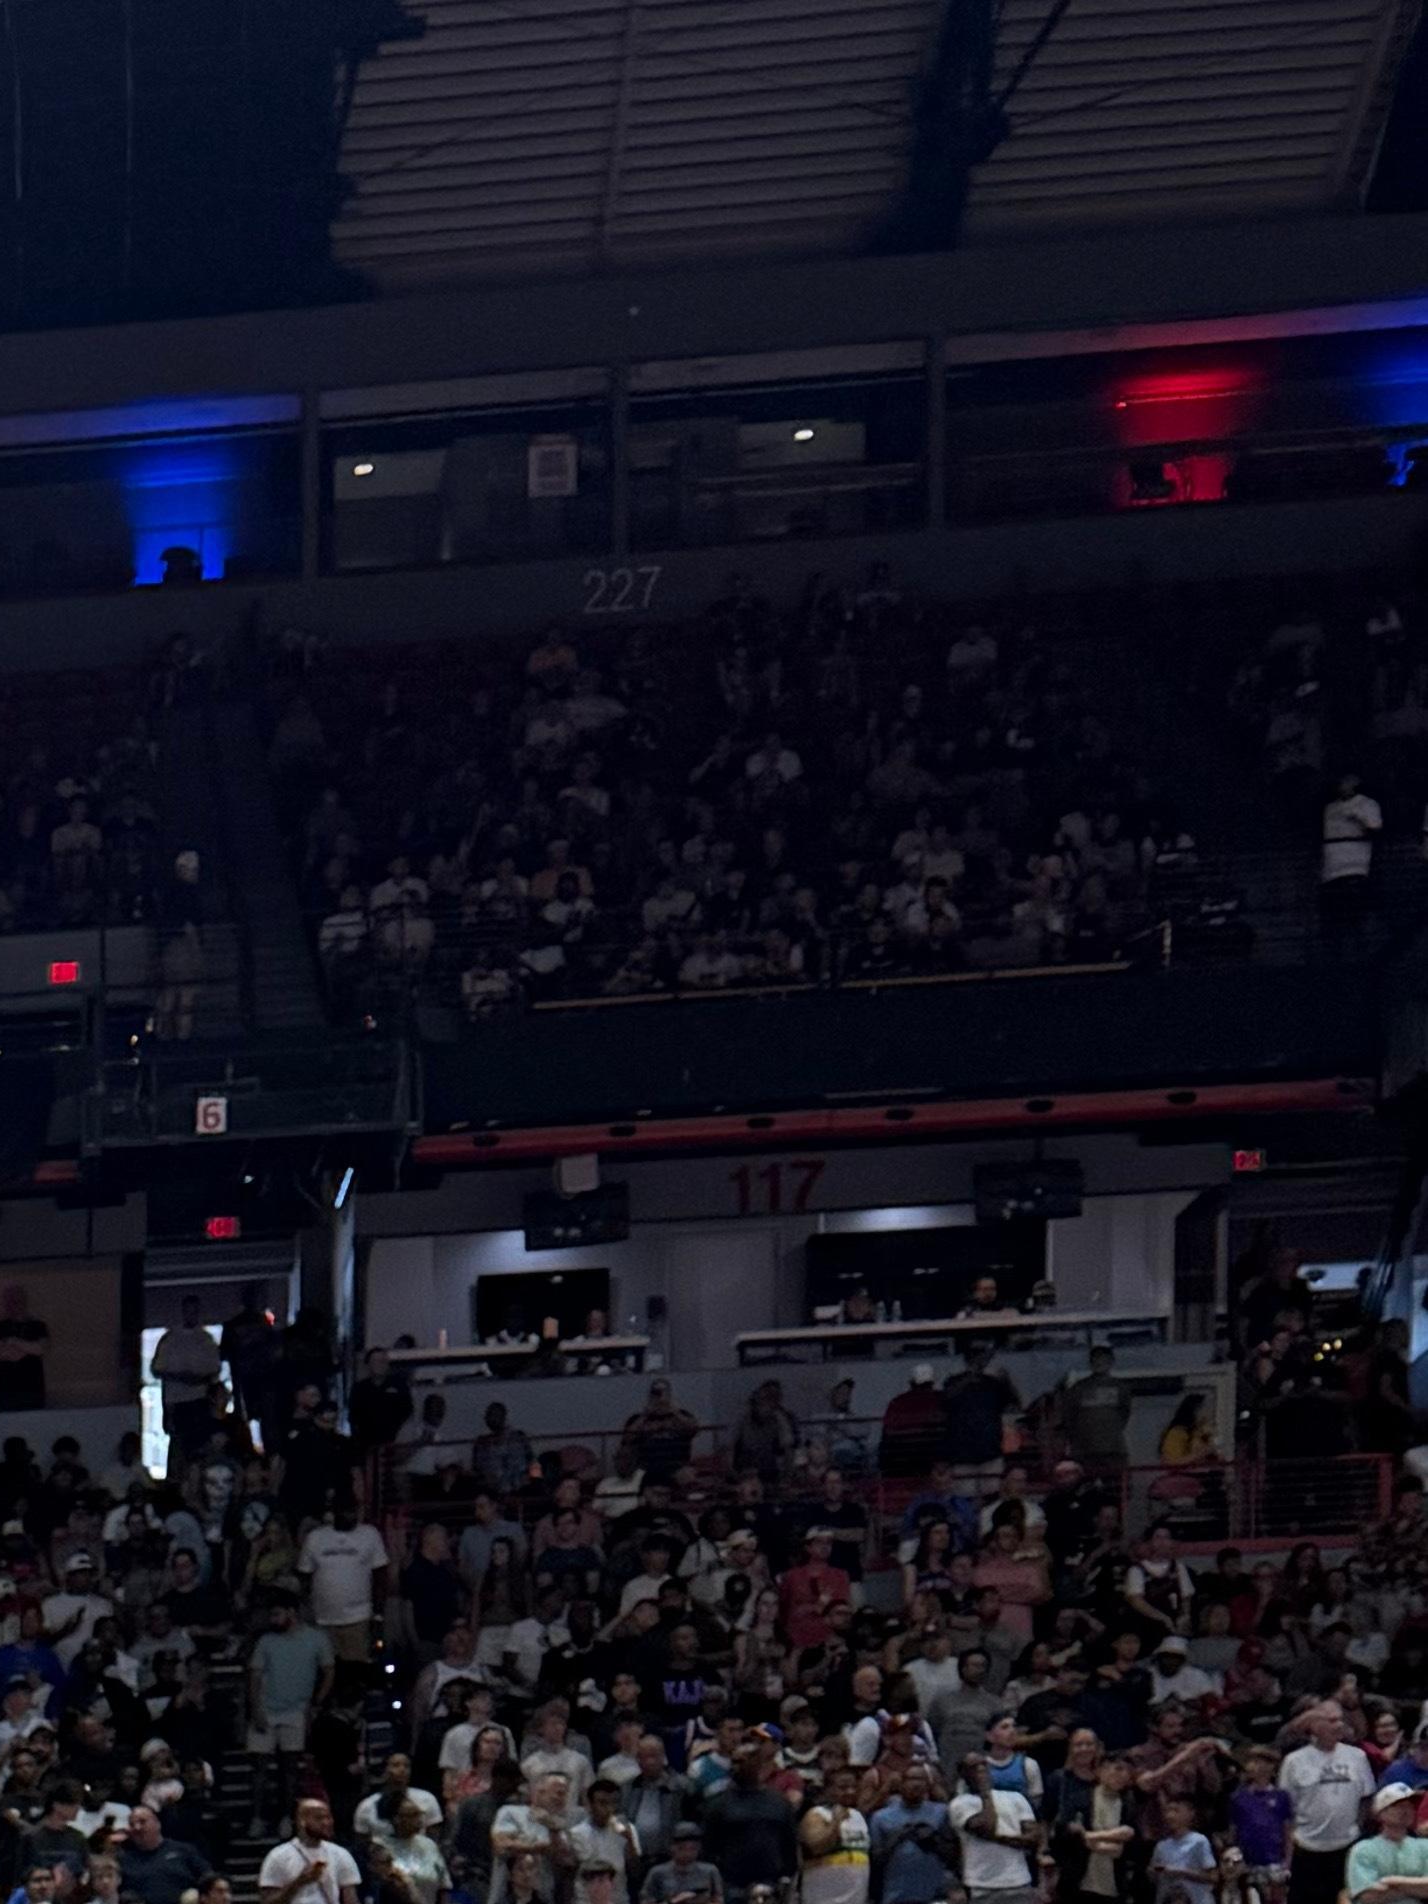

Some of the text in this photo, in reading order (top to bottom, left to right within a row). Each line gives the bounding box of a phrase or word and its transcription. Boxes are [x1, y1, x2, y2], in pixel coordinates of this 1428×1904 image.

[584, 565, 662, 613] 227
[202, 1102, 222, 1130] 6
[728, 1160, 825, 1215] 117
